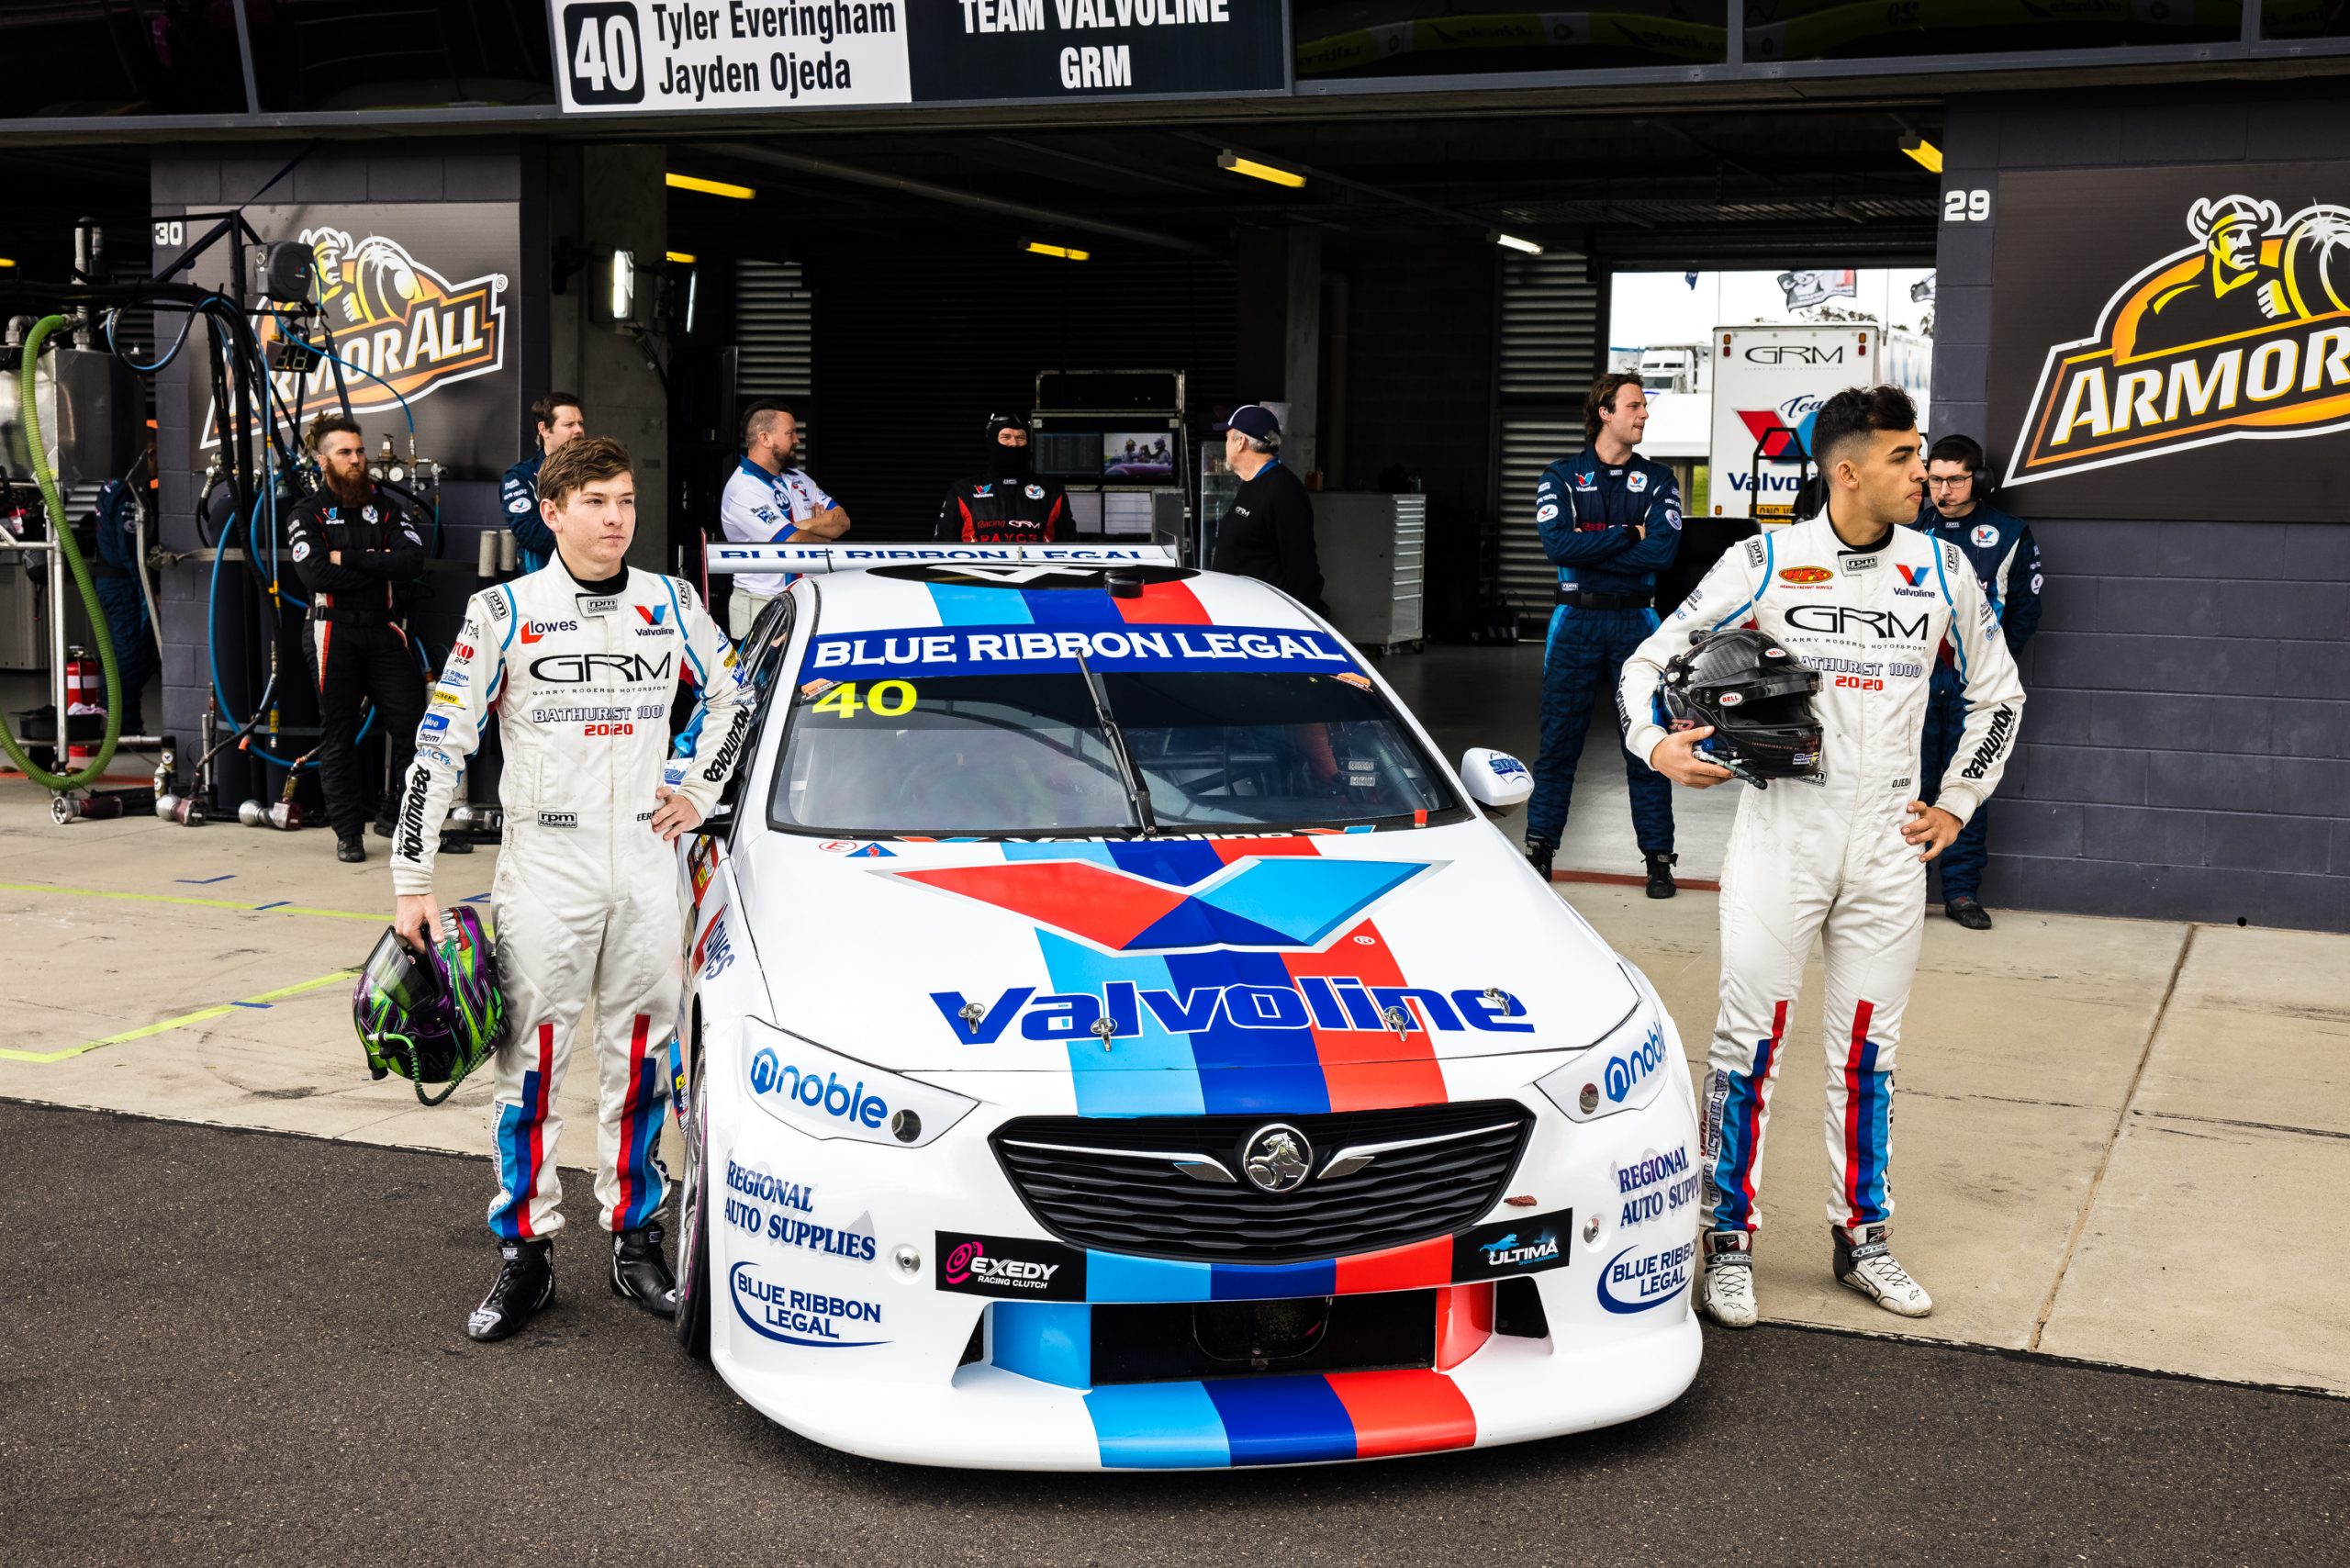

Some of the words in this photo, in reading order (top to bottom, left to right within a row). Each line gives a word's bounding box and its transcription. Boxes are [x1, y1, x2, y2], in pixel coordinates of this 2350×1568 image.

[653, 3, 720, 50] Tyler
[730, 0, 896, 44] Everingham
[959, 0, 1045, 33] TEAM
[1055, 0, 1230, 29] VALVOLINE
[575, 15, 638, 92] 40
[1060, 45, 1132, 89] GRM
[659, 55, 760, 103] Jayden
[770, 51, 852, 99] Ojeda
[1943, 190, 1990, 222] 29
[154, 221, 184, 246] 30
[1745, 346, 1843, 364] GRM
[1780, 394, 1826, 419] Tea
[1751, 540, 1764, 565] rpm
[1848, 557, 1876, 566] rpm
[488, 590, 507, 617] rpm
[589, 599, 616, 608] rpm
[1893, 588, 1936, 599] Valvoline
[530, 619, 578, 633] lowes
[635, 626, 675, 636] Valvoline
[1785, 605, 1930, 641] GRM
[812, 639, 957, 668] BLUE
[968, 632, 1176, 664] RIBBON
[1182, 632, 1348, 663] LEGAL
[529, 651, 671, 683] GRM
[1794, 656, 1884, 677] ATHURST
[1888, 662, 1922, 678] 1000
[1835, 675, 1884, 691] 2020
[532, 706, 632, 723] BATHURST
[811, 680, 918, 719] 40
[1721, 695, 1740, 703] BELL
[584, 723, 633, 736] 2020
[1961, 702, 2014, 779] REVOLUTION
[403, 763, 431, 864] REVOLUTION
[541, 812, 576, 822] rpm
[929, 976, 1536, 1045] Valvoline
[778, 1065, 889, 1129] noble
[1707, 1068, 1728, 1160] BATHURST
[1617, 1145, 1690, 1194] REGIONAL
[726, 1159, 814, 1213] REGIONAL
[1619, 1191, 1663, 1228] AUTO
[724, 1197, 762, 1233] AUTO
[767, 1215, 877, 1261] SUPPLIES
[1489, 1239, 1559, 1266] ULTIMA
[970, 1256, 1060, 1281] EXEDY
[978, 1275, 1010, 1286] RACING
[1013, 1279, 1048, 1290] CLUTCH
[1613, 1257, 1662, 1283] BLUE
[1639, 1266, 1686, 1297] LEGAL
[737, 1271, 786, 1307] BLUE
[789, 1289, 881, 1323] RIBBON
[766, 1305, 840, 1339] LEGAL
